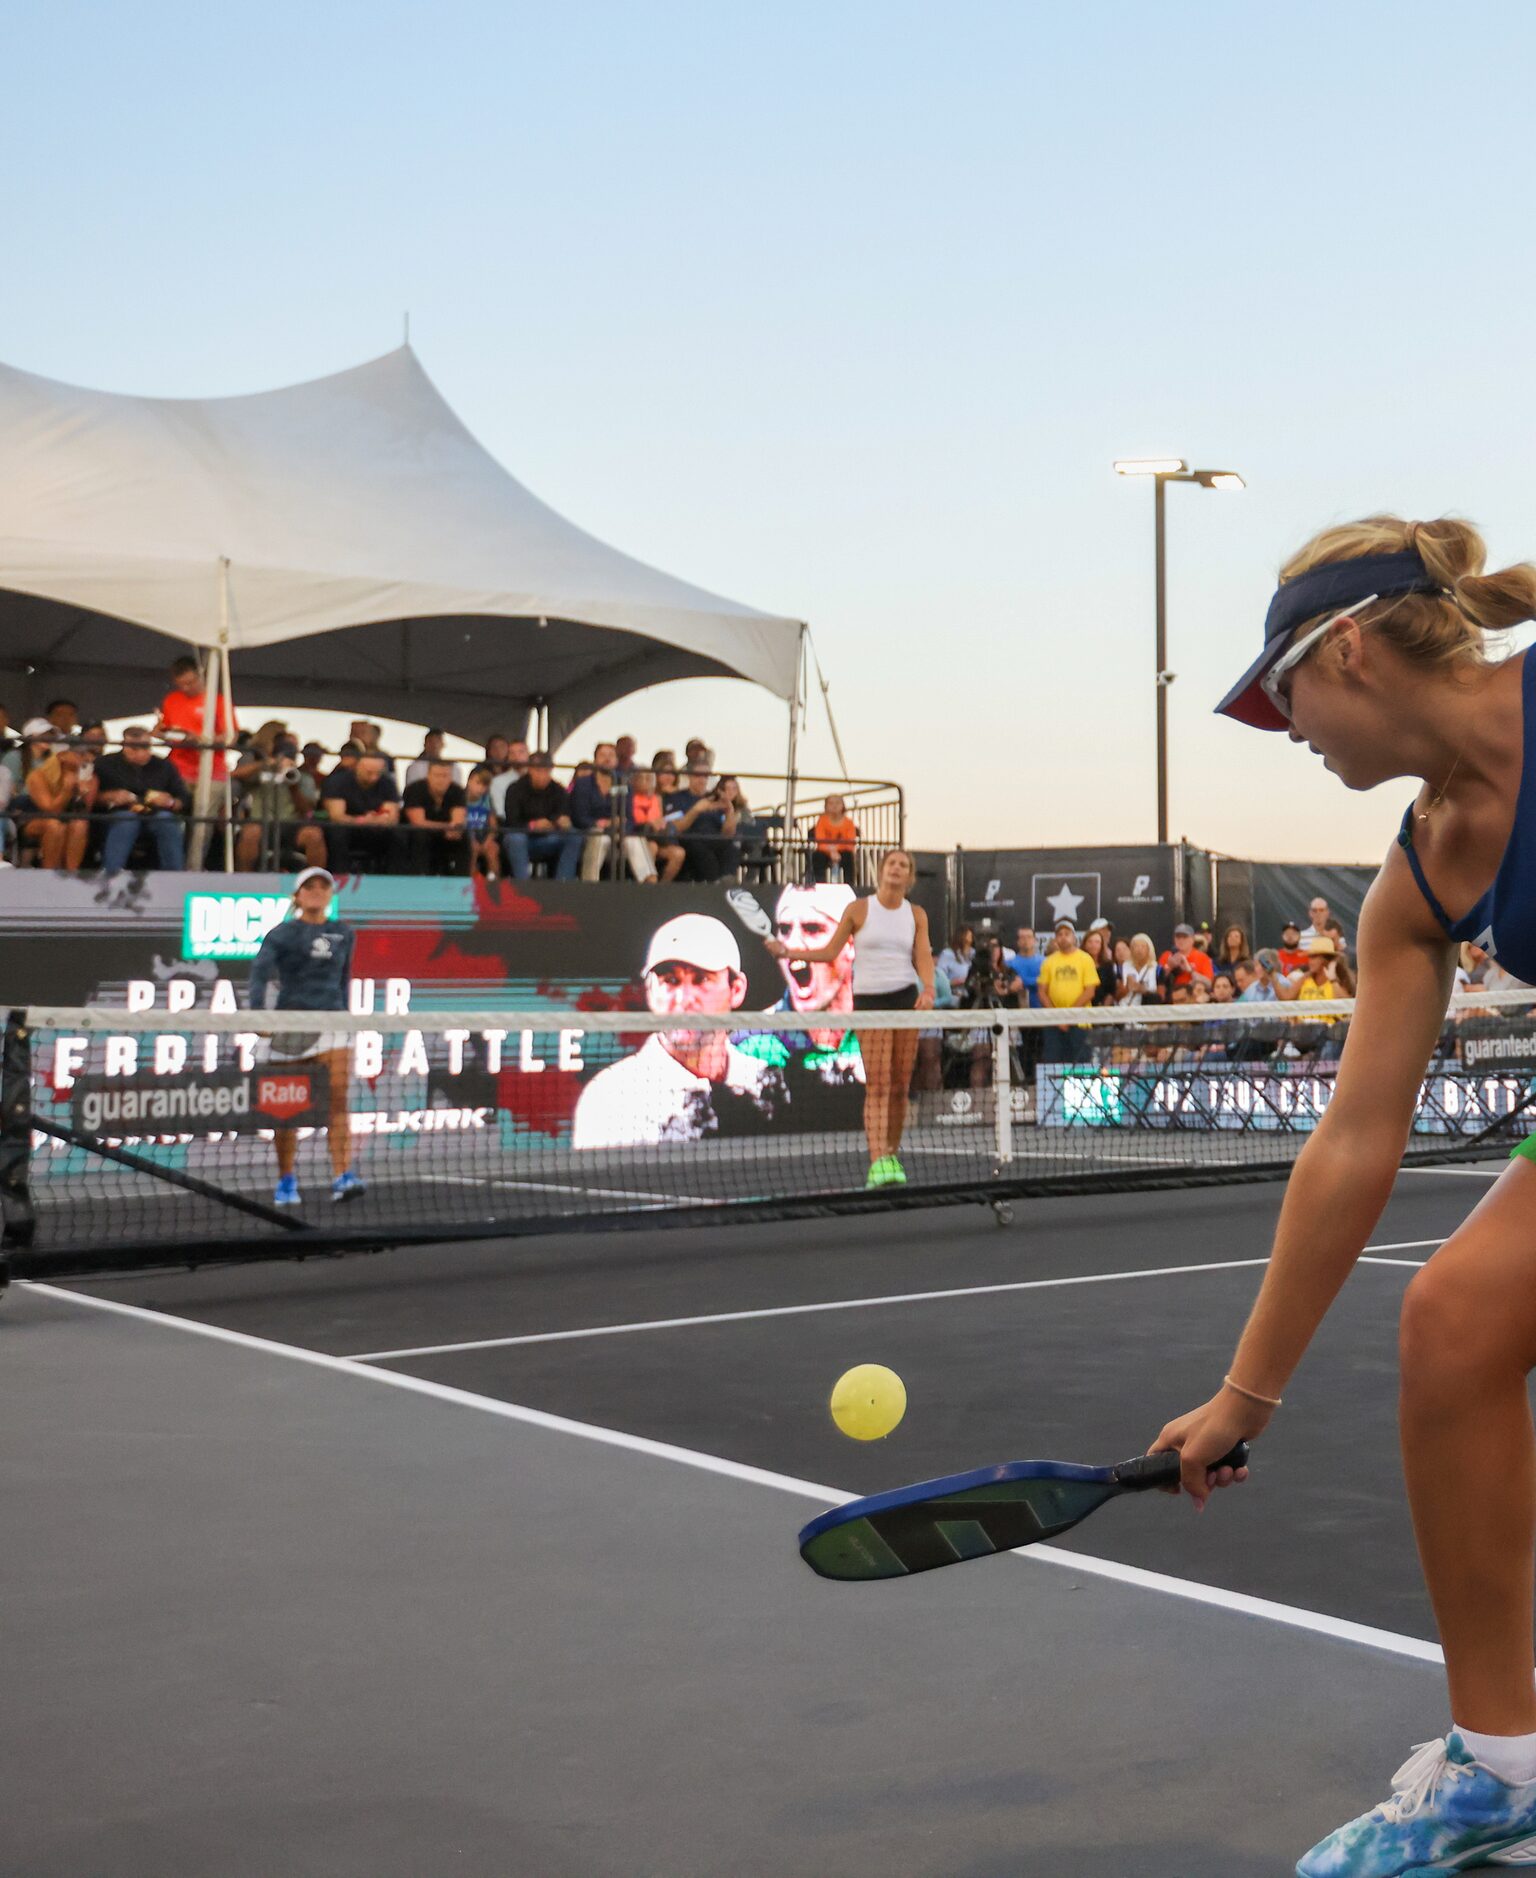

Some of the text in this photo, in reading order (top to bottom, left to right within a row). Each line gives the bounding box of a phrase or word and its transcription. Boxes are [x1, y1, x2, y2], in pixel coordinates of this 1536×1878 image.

[353, 1028, 585, 1079] BATTLE
[81, 1077, 308, 1132] guaranteed Rate
